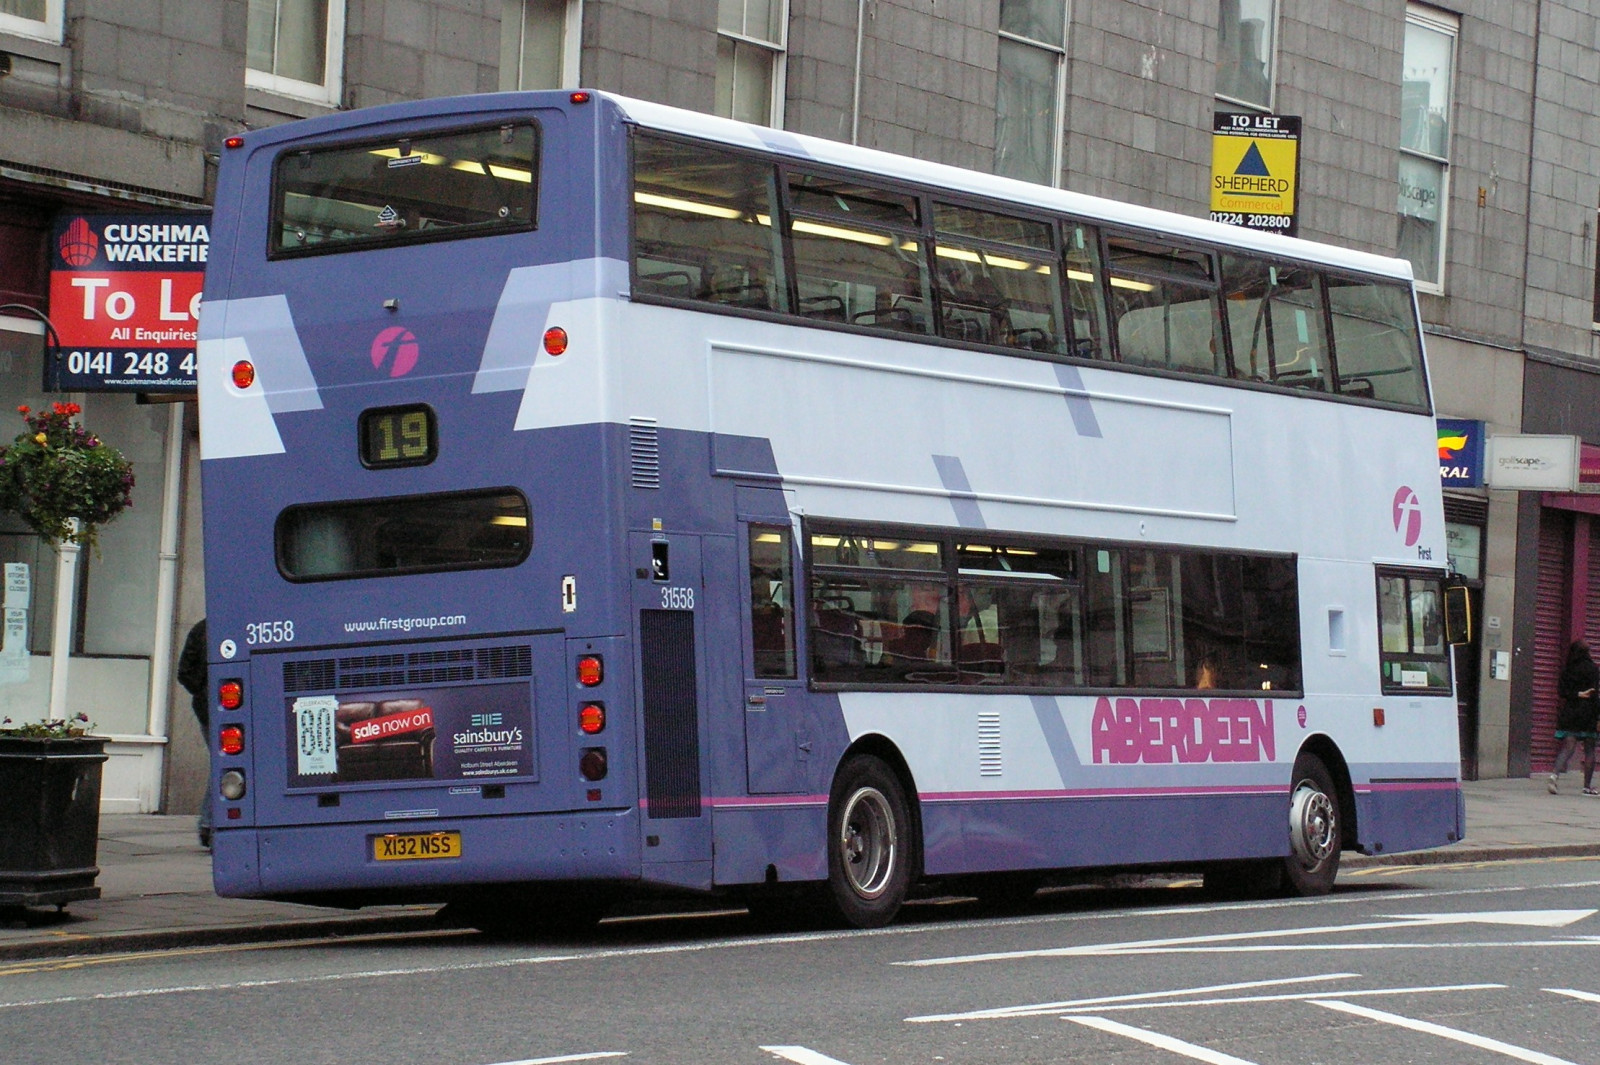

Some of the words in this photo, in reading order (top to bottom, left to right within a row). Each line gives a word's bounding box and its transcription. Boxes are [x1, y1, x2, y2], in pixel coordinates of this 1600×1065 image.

[1230, 115, 1251, 127] TO
[1255, 116, 1280, 129] LET
[1215, 175, 1289, 193] SHEPHERD
[1220, 197, 1283, 211] Commercial
[1210, 212, 1243, 225] 01224
[1247, 214, 1291, 228] 202800
[104, 225, 209, 242] CUSHMA
[104, 245, 208, 262] WAKEFIE
[71, 278, 136, 320] To
[110, 328, 130, 340] All
[135, 328, 198, 344] Enquiries
[68, 352, 111, 374] 0141
[124, 352, 169, 375] 248
[179, 353, 198, 375] 4
[104, 377, 198, 387] www.cushmanwakefield.com
[379, 412, 428, 460] 19
[1439, 466, 1470, 478] RAL
[1418, 545, 1432, 560] First
[661, 587, 695, 609] 31558
[344, 614, 467, 632] www.firstgroup.com
[246, 620, 295, 645] 31558
[354, 723, 380, 740] sale
[382, 717, 410, 736] now
[412, 711, 431, 727] on
[1091, 696, 1276, 764] ABERDEEN
[453, 726, 523, 745] sainsbury's
[383, 838, 417, 856] X132
[421, 836, 451, 854] NSS
